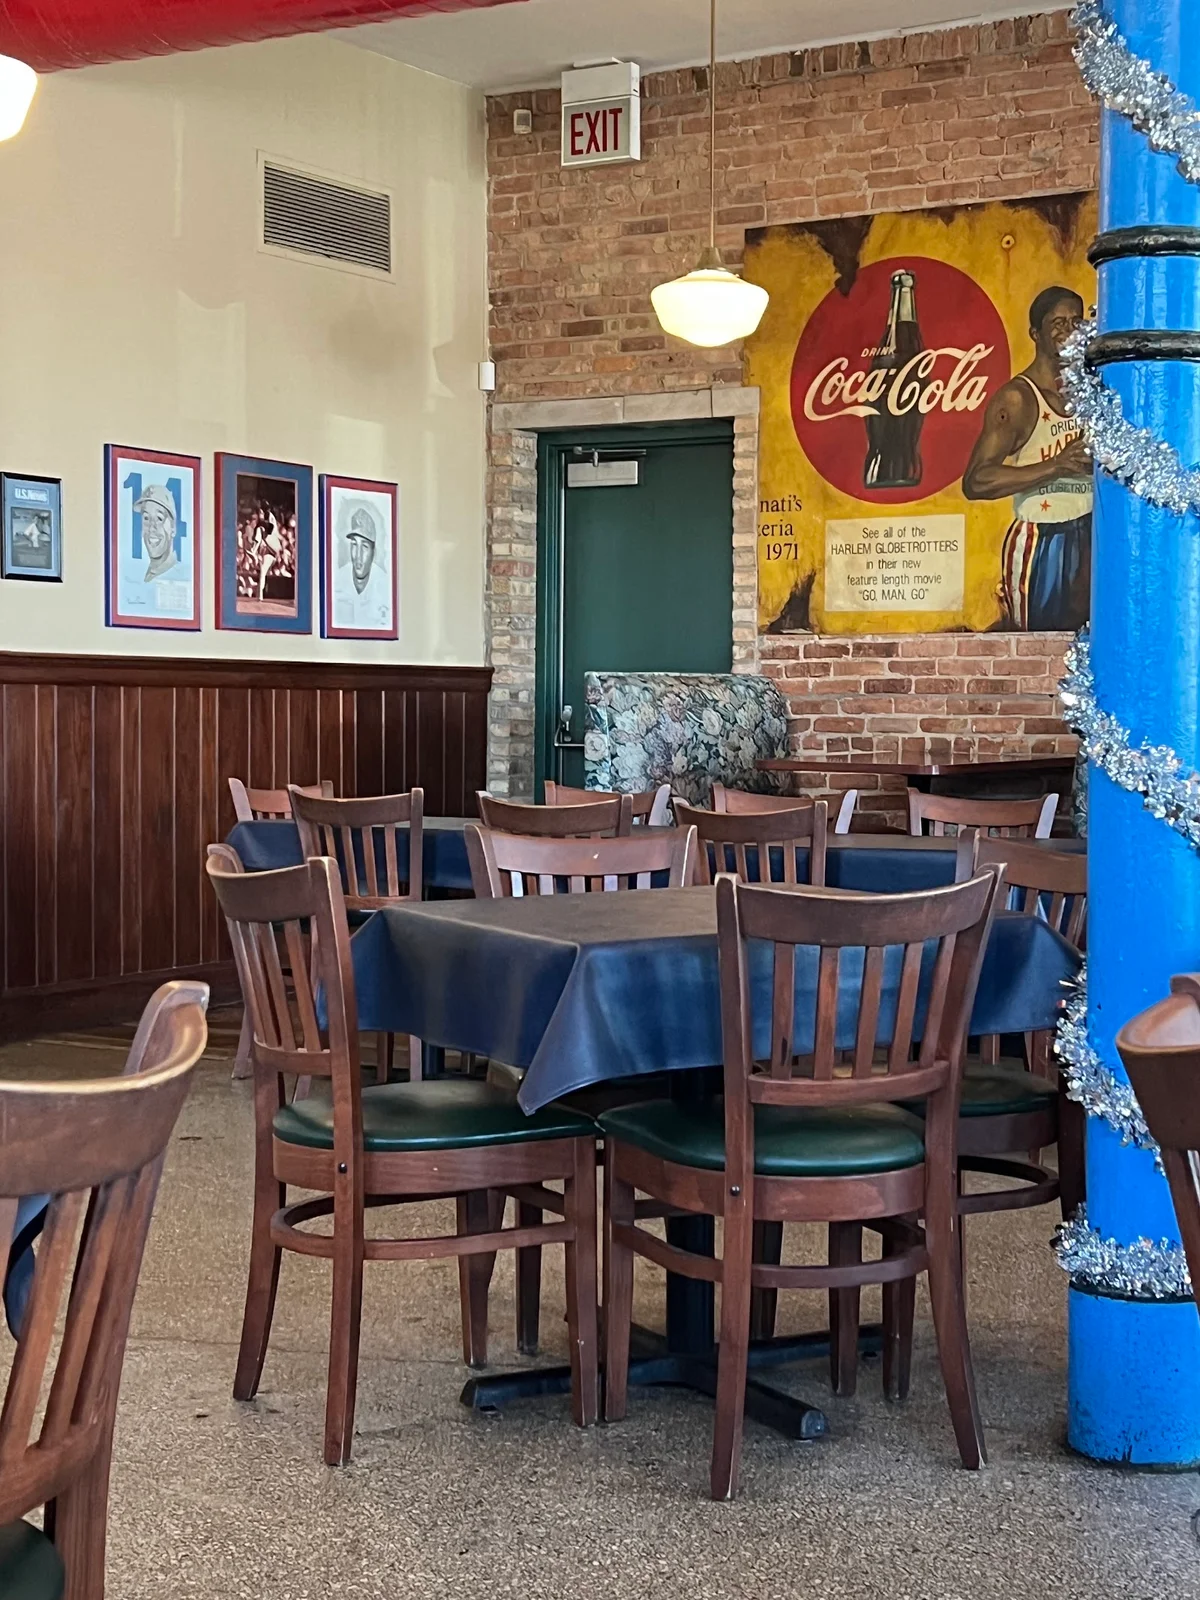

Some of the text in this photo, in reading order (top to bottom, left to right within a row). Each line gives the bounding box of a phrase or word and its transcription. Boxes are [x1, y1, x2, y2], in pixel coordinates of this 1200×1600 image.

[570, 107, 623, 156] EXIT
[861, 346, 896, 359] DRINK
[803, 343, 995, 421] Coca-Cola
[862, 525, 926, 539] See all of the
[766, 542, 798, 561] 1971
[831, 540, 959, 556] HARLEM GLOBETROTTERS
[866, 558, 921, 570] in their new
[847, 573, 942, 588] feature length movie
